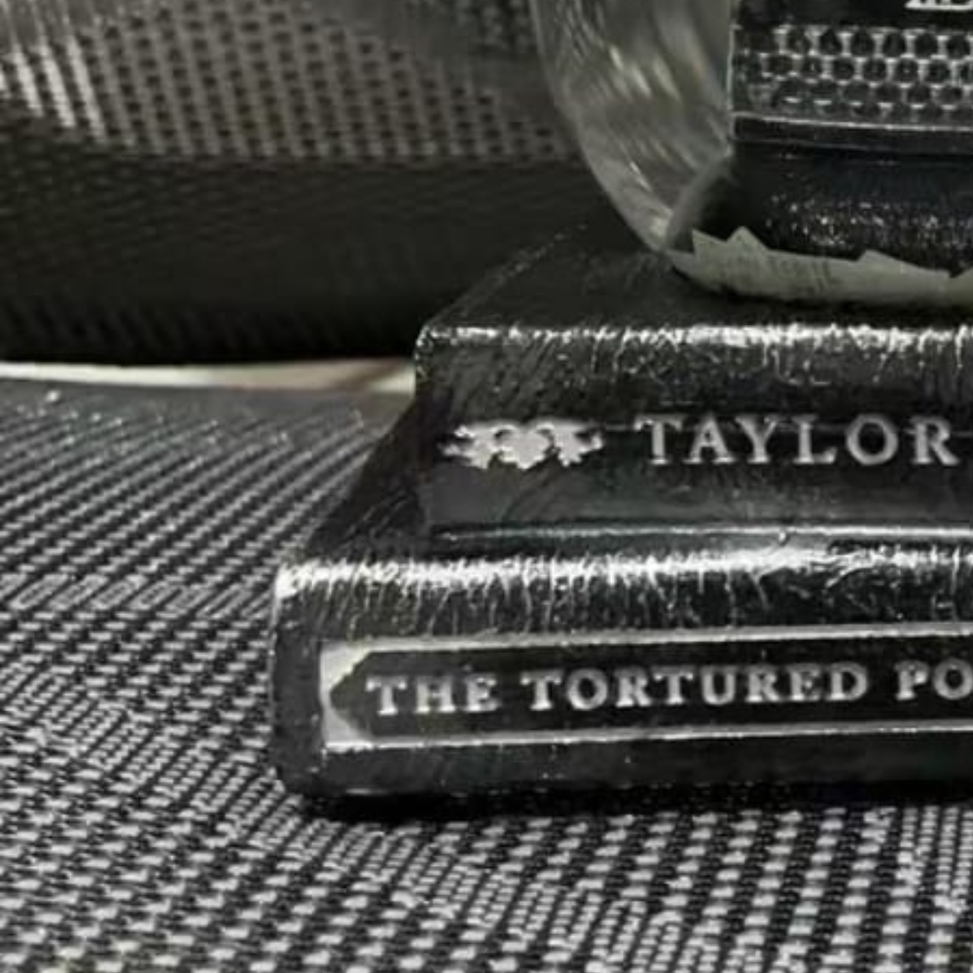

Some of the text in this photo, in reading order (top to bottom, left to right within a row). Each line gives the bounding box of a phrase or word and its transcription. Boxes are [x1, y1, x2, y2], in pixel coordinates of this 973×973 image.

[634, 414, 958, 466] TAYLOR
[366, 672, 498, 716] THE
[520, 662, 868, 712] TORTURED
